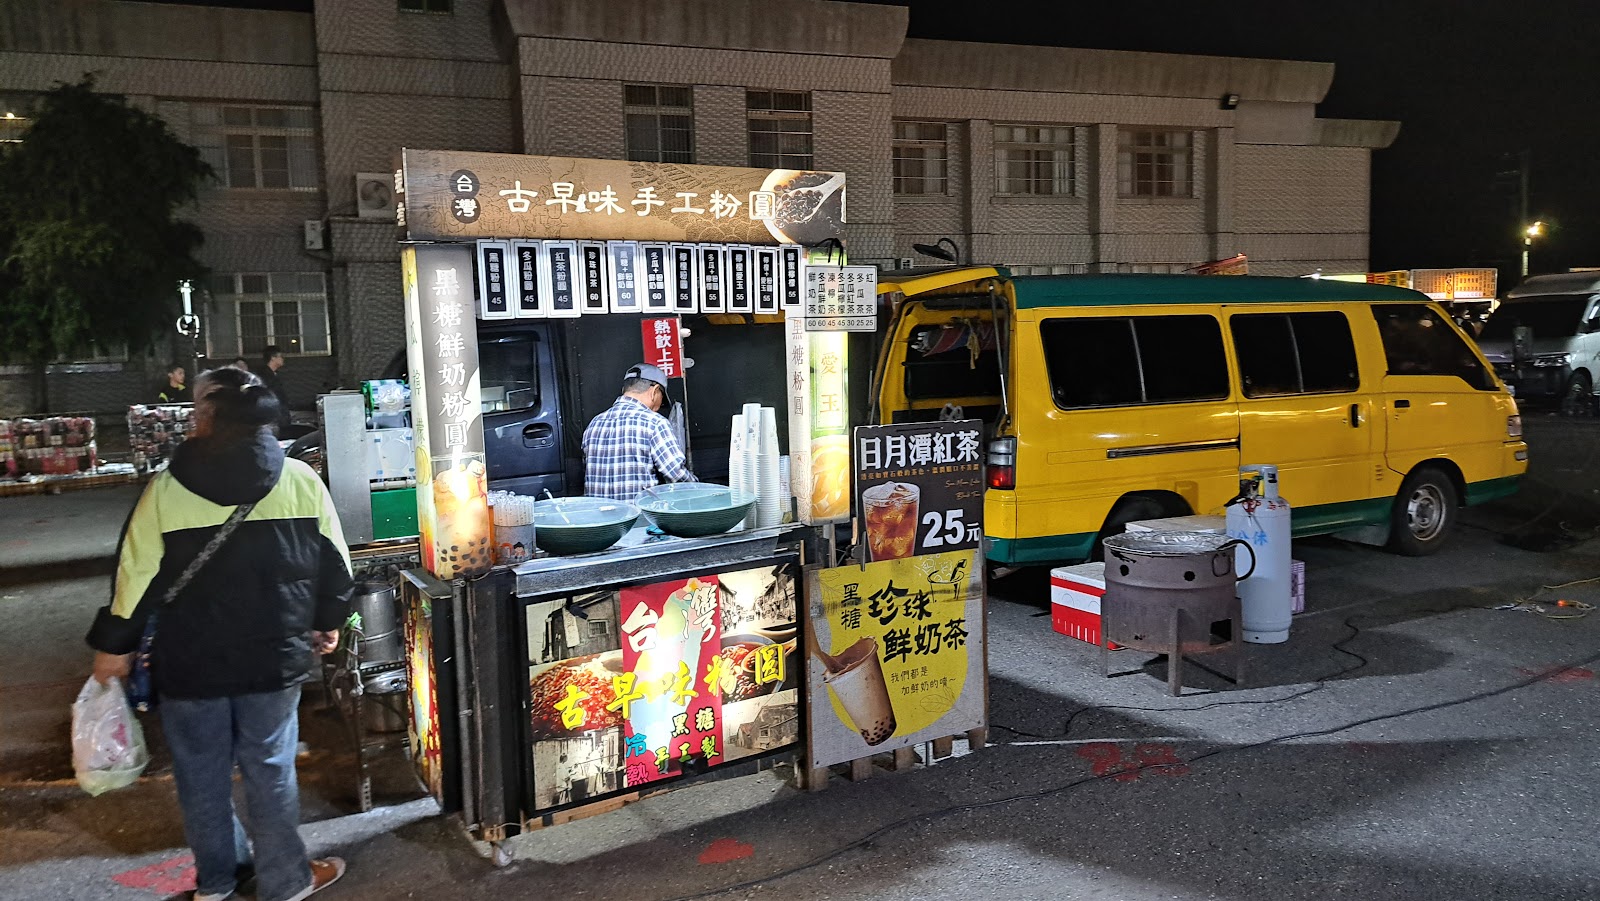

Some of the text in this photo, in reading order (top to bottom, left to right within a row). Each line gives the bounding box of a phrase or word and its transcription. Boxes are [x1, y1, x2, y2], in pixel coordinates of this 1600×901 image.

[455, 174, 478, 218] 台灣
[498, 179, 777, 221] 古早味手工粉圓
[488, 252, 501, 293] 黑糖粉圓
[522, 251, 534, 291] 冬瓜粉圓
[554, 252, 567, 291] 紅茶粉圓
[588, 251, 598, 288] 珍珠奶茶
[679, 252, 688, 290] 檸檬粉圓
[735, 253, 744, 290] 檸檬愛玉
[787, 252, 796, 287] 蜂蜜檸檬
[491, 297, 502, 305] 45
[524, 295, 535, 303] 45
[557, 295, 568, 303] 45
[589, 293, 599, 301] 60
[808, 272, 816, 314] 鮮奶茶
[818, 272, 826, 314] 冬瓜鮮奶
[837, 272, 845, 314] 冬瓜檸檬
[847, 272, 855, 314] 冬瓜紅茶
[856, 272, 865, 314] 冬瓜茶
[431, 267, 471, 448] 黑糖鮮奶粉圓
[654, 319, 675, 377] 熱飲上市
[791, 319, 805, 417] 黑糖粉圓
[860, 430, 980, 471] 日月潭紅茶
[620, 585, 718, 653] 台灣
[841, 583, 862, 631] 黑糖
[867, 579, 932, 626] 珍珠
[882, 617, 969, 664] 鮮奶茶
[553, 643, 786, 731] 古早味粉圓
[890, 665, 929, 684] 我們都是
[671, 706, 715, 738] 黑糖
[654, 735, 720, 775] 手工製
